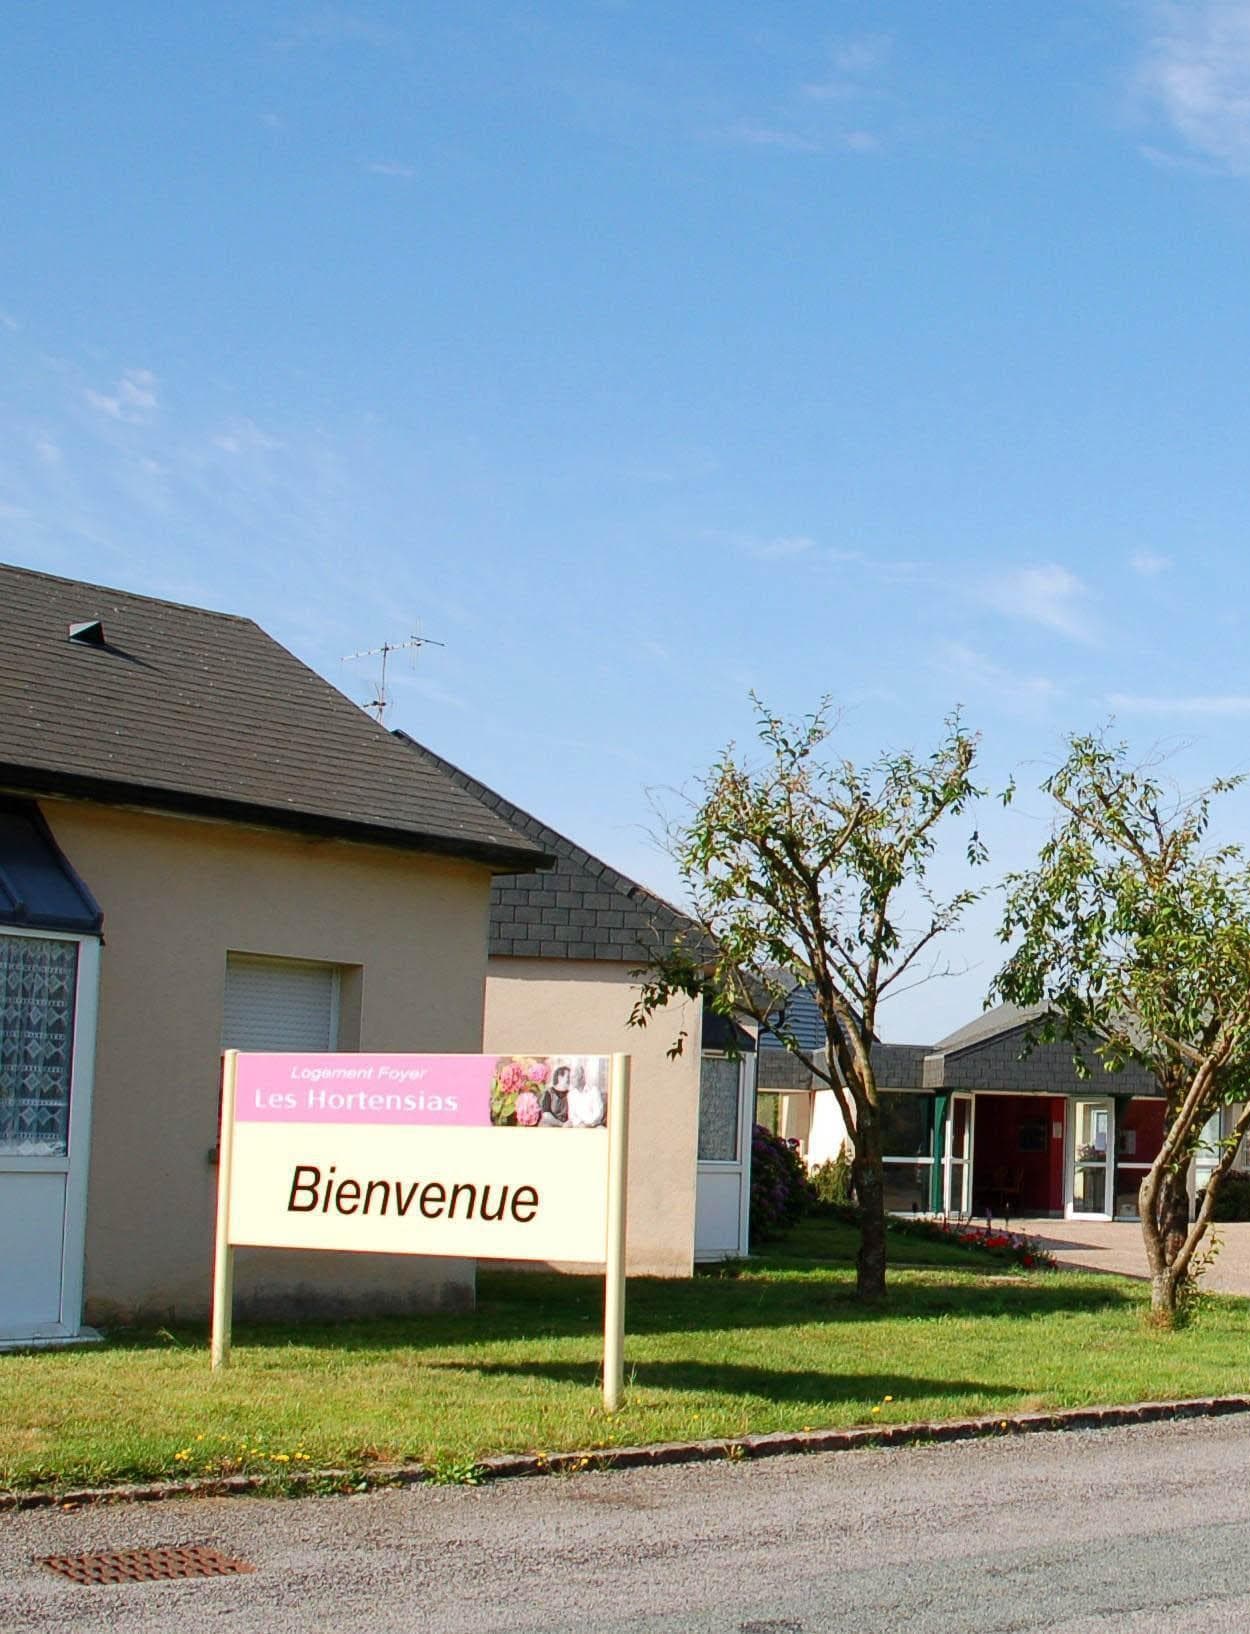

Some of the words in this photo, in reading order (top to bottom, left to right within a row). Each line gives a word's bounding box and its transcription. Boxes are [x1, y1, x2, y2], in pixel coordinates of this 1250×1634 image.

[290, 1065, 373, 1082] Logement
[377, 1066, 427, 1083] Foyer
[254, 1088, 298, 1109] Les
[307, 1089, 459, 1112] Hortensias
[287, 1165, 540, 1223] Bienvenue
